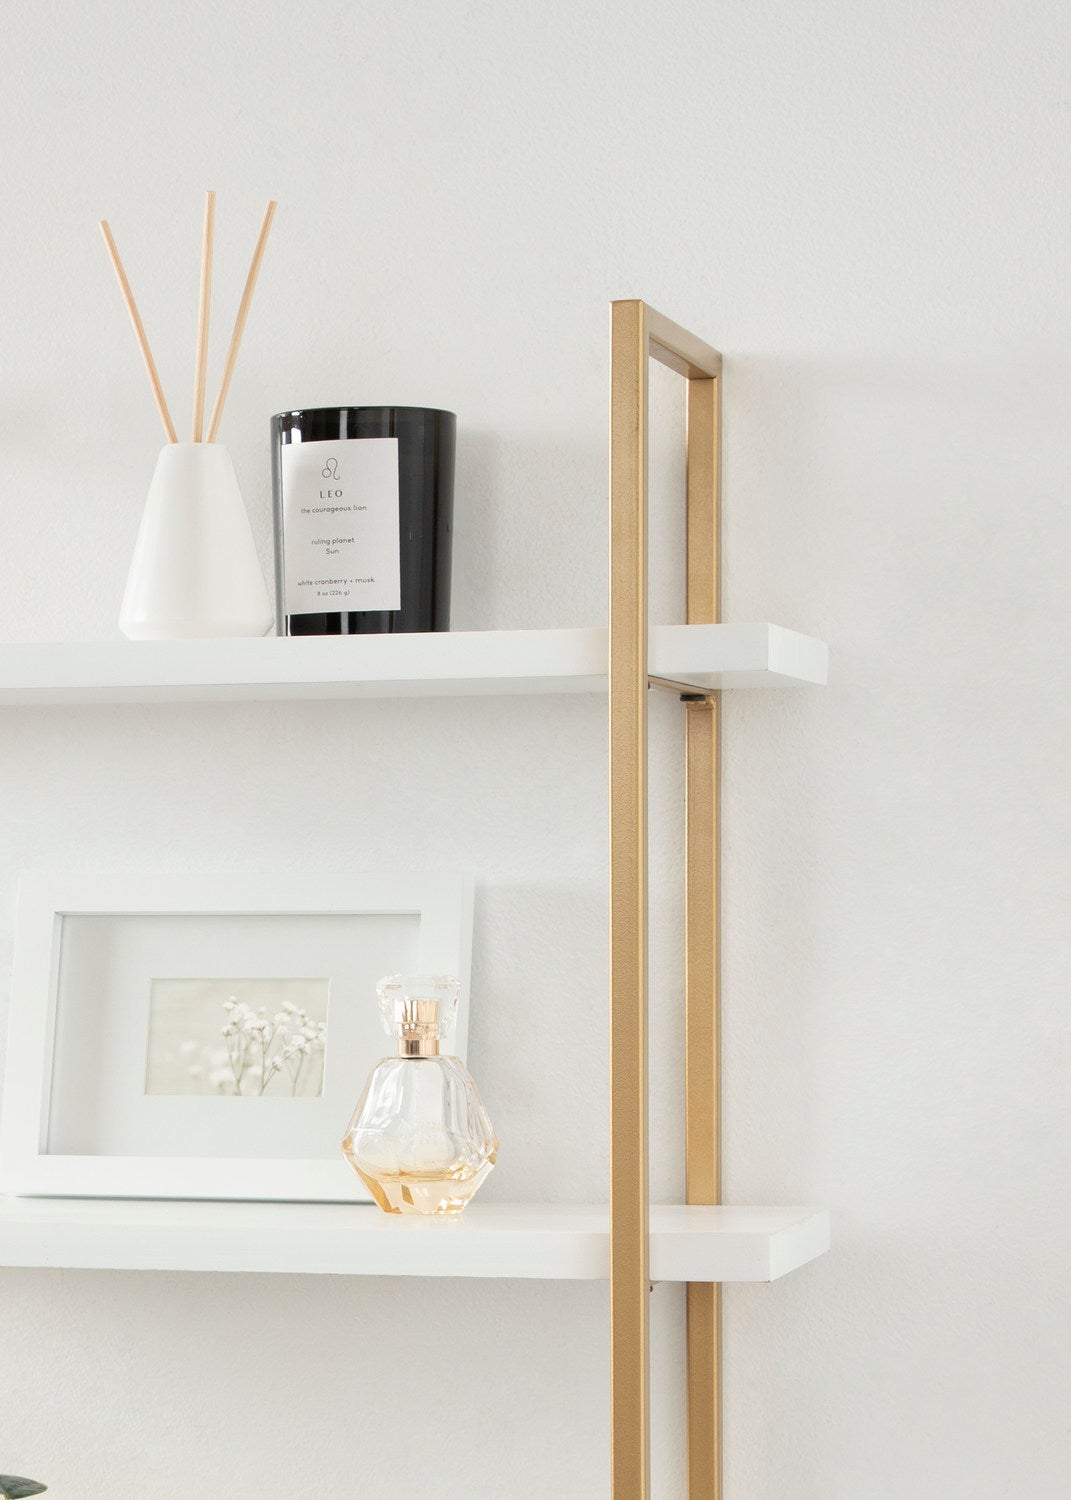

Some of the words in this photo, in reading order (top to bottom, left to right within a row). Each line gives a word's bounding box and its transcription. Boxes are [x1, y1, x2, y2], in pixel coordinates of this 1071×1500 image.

[319, 489, 343, 499] LEO
[312, 505, 352, 514] courageous
[311, 538, 331, 546] ruling
[331, 537, 356, 546] planet
[325, 547, 340, 555] Sun
[314, 578, 348, 586] cranberry
[354, 576, 375, 584] musk
